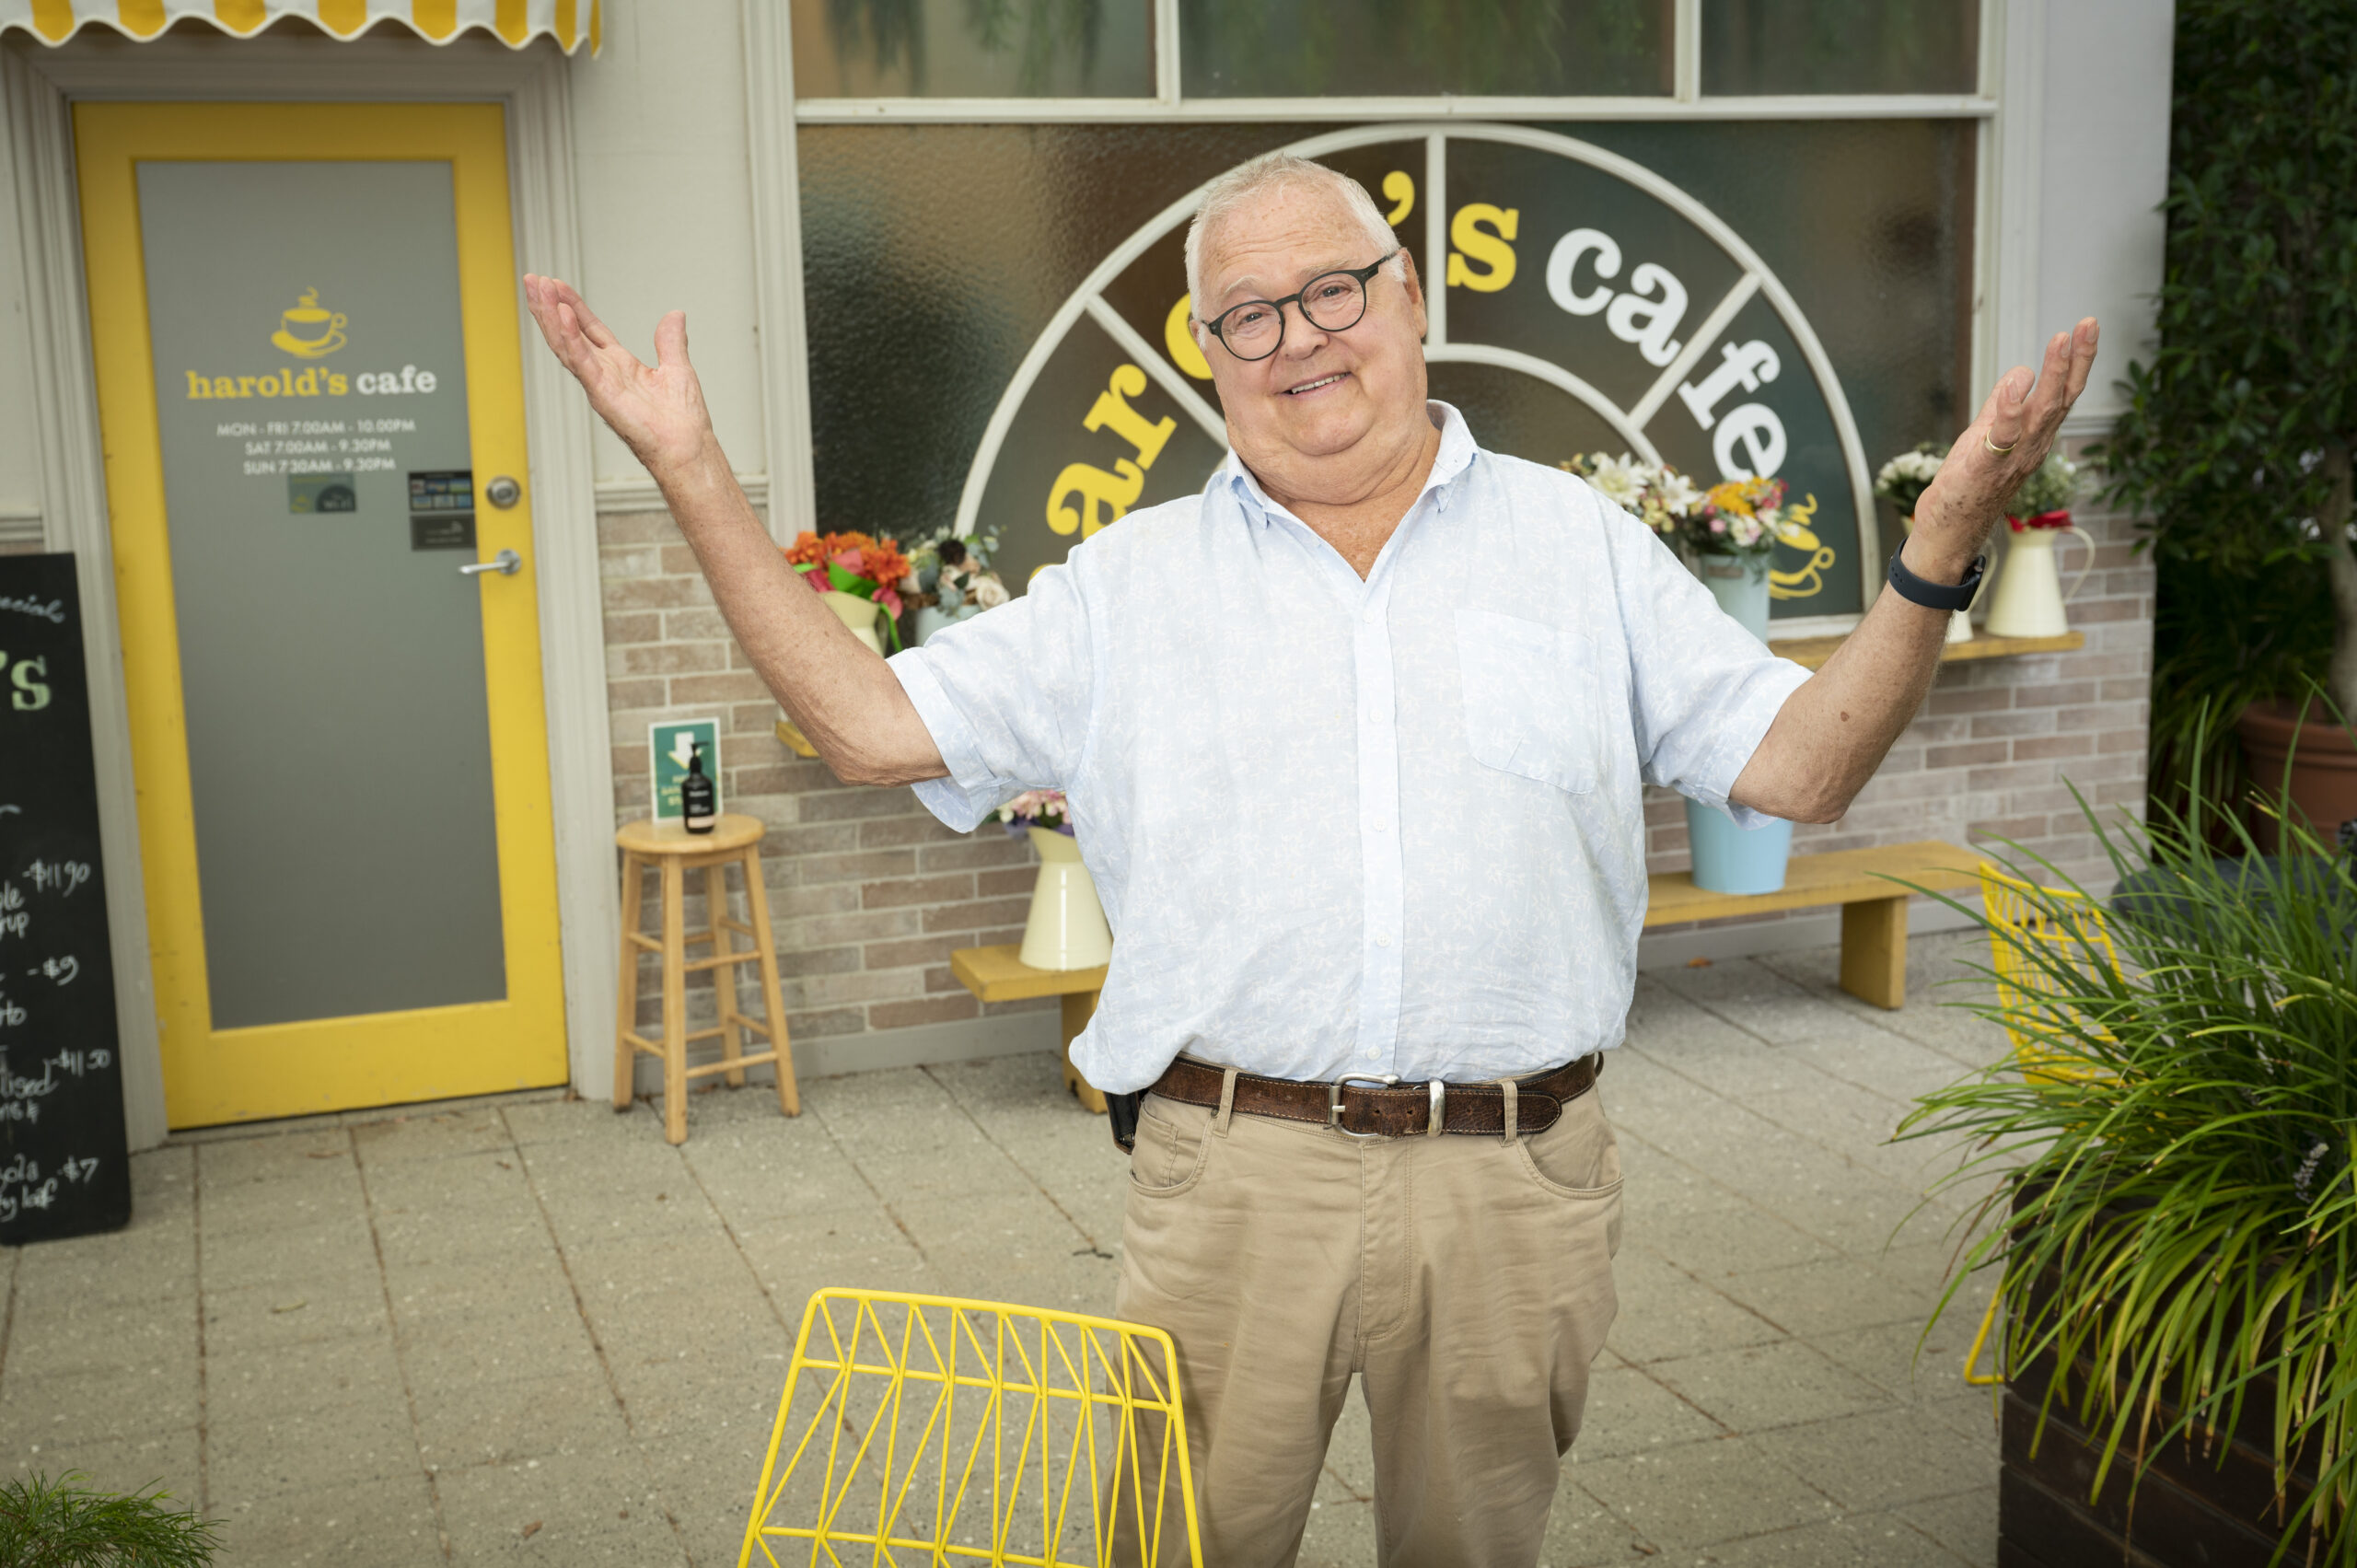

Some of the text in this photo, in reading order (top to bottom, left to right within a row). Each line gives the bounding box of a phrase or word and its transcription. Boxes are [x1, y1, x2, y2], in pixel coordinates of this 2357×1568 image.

[1546, 228, 1787, 481] cafe
[186, 365, 437, 399] harold's cafe
[217, 423, 258, 436] MON
[266, 422, 289, 436] FRI
[245, 441, 271, 456] SAT
[243, 459, 276, 475] SUN
